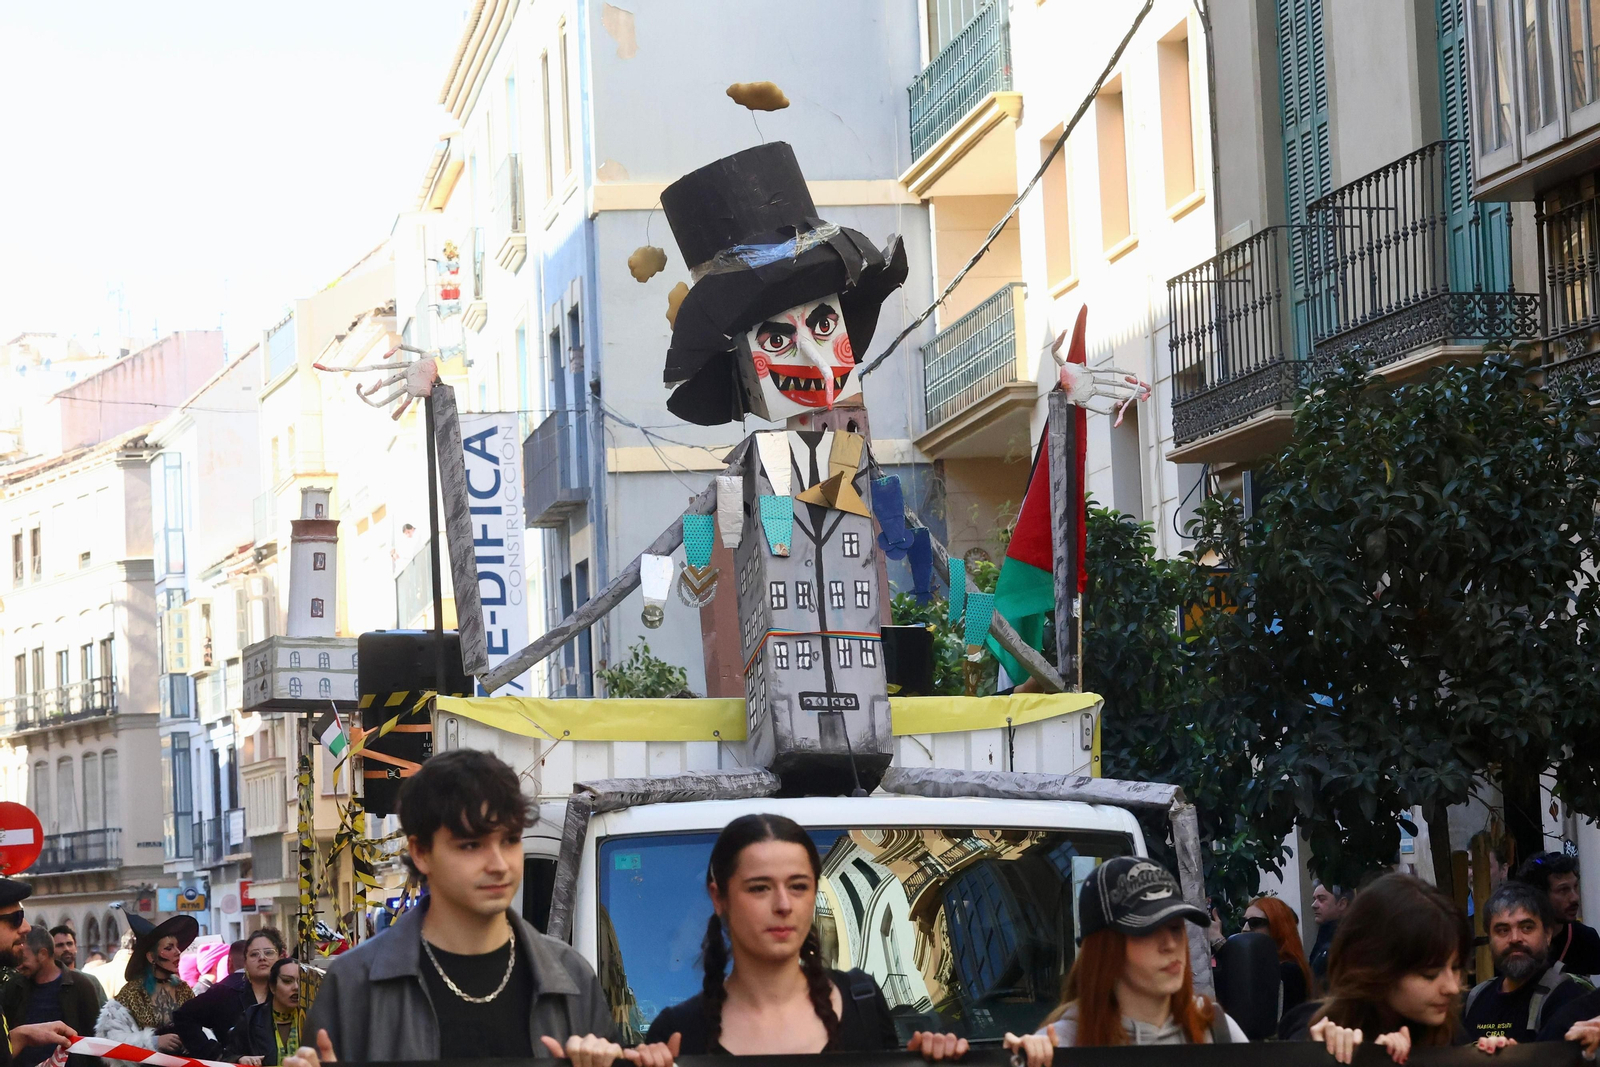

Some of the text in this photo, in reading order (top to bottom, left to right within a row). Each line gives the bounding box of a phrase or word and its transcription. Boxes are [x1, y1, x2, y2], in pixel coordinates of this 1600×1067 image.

[463, 425, 509, 655] E-DIFICA
[501, 425, 523, 606] CONSTRUCCIÓN
[180, 902, 201, 910] ATM
